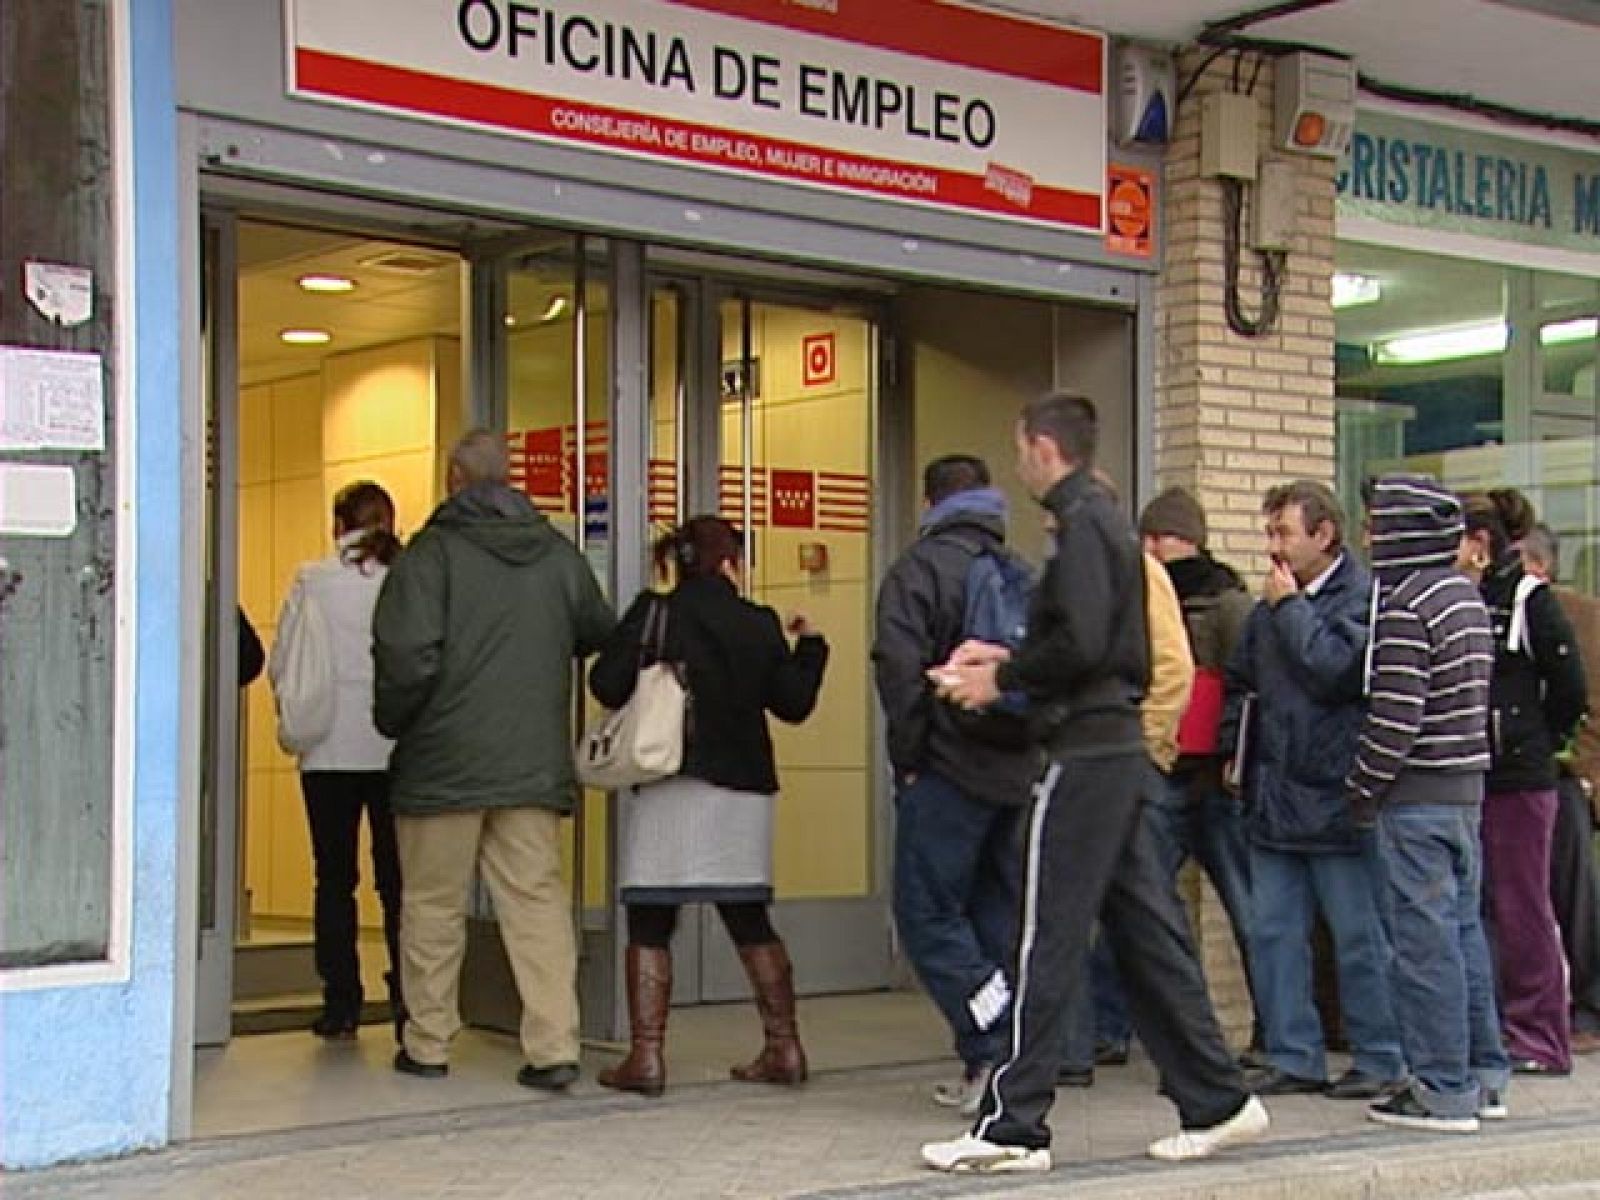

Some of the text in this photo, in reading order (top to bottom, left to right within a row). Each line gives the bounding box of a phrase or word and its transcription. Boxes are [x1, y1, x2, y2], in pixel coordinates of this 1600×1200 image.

[459, 0, 996, 148] OFICINA DE EMPLEO
[664, 126, 689, 150] DE
[766, 147, 821, 174] MUJER
[824, 157, 835, 177] E
